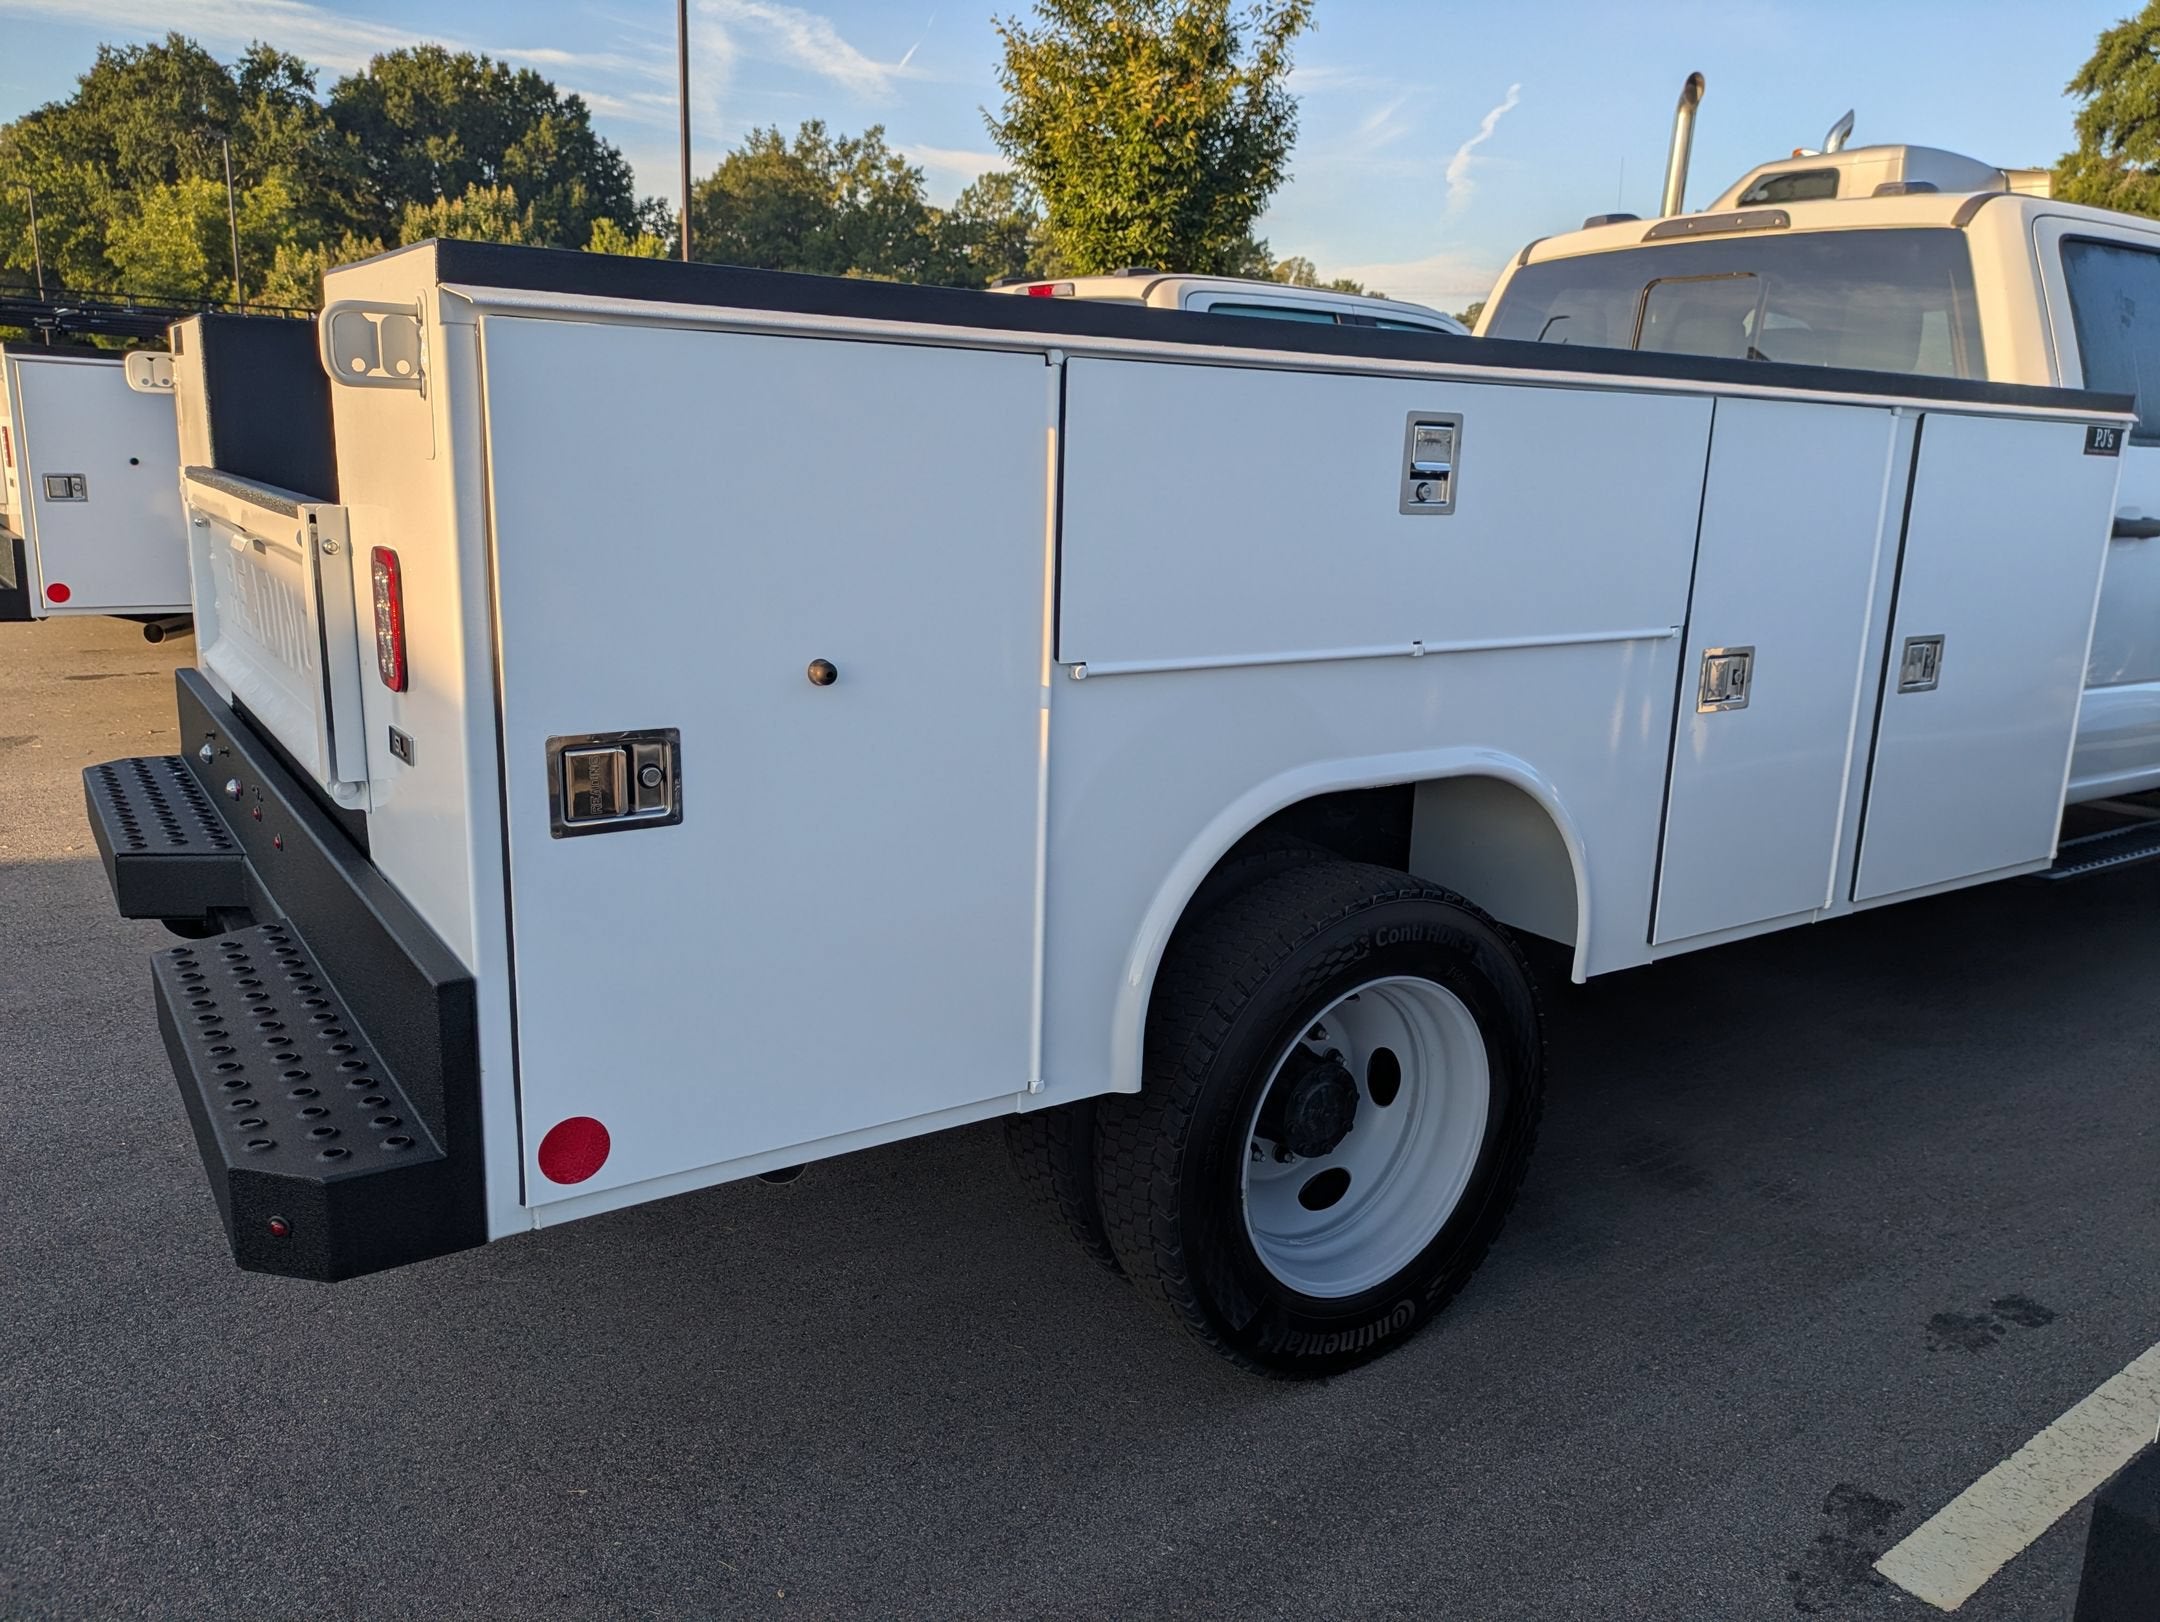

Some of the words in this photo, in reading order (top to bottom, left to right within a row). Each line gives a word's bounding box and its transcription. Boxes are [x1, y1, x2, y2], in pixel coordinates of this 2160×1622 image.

[2093, 428, 2114, 448] PJ's
[588, 754, 604, 816] READING
[1375, 921, 1424, 948] Conti
[1271, 1299, 1416, 1358] Continental
